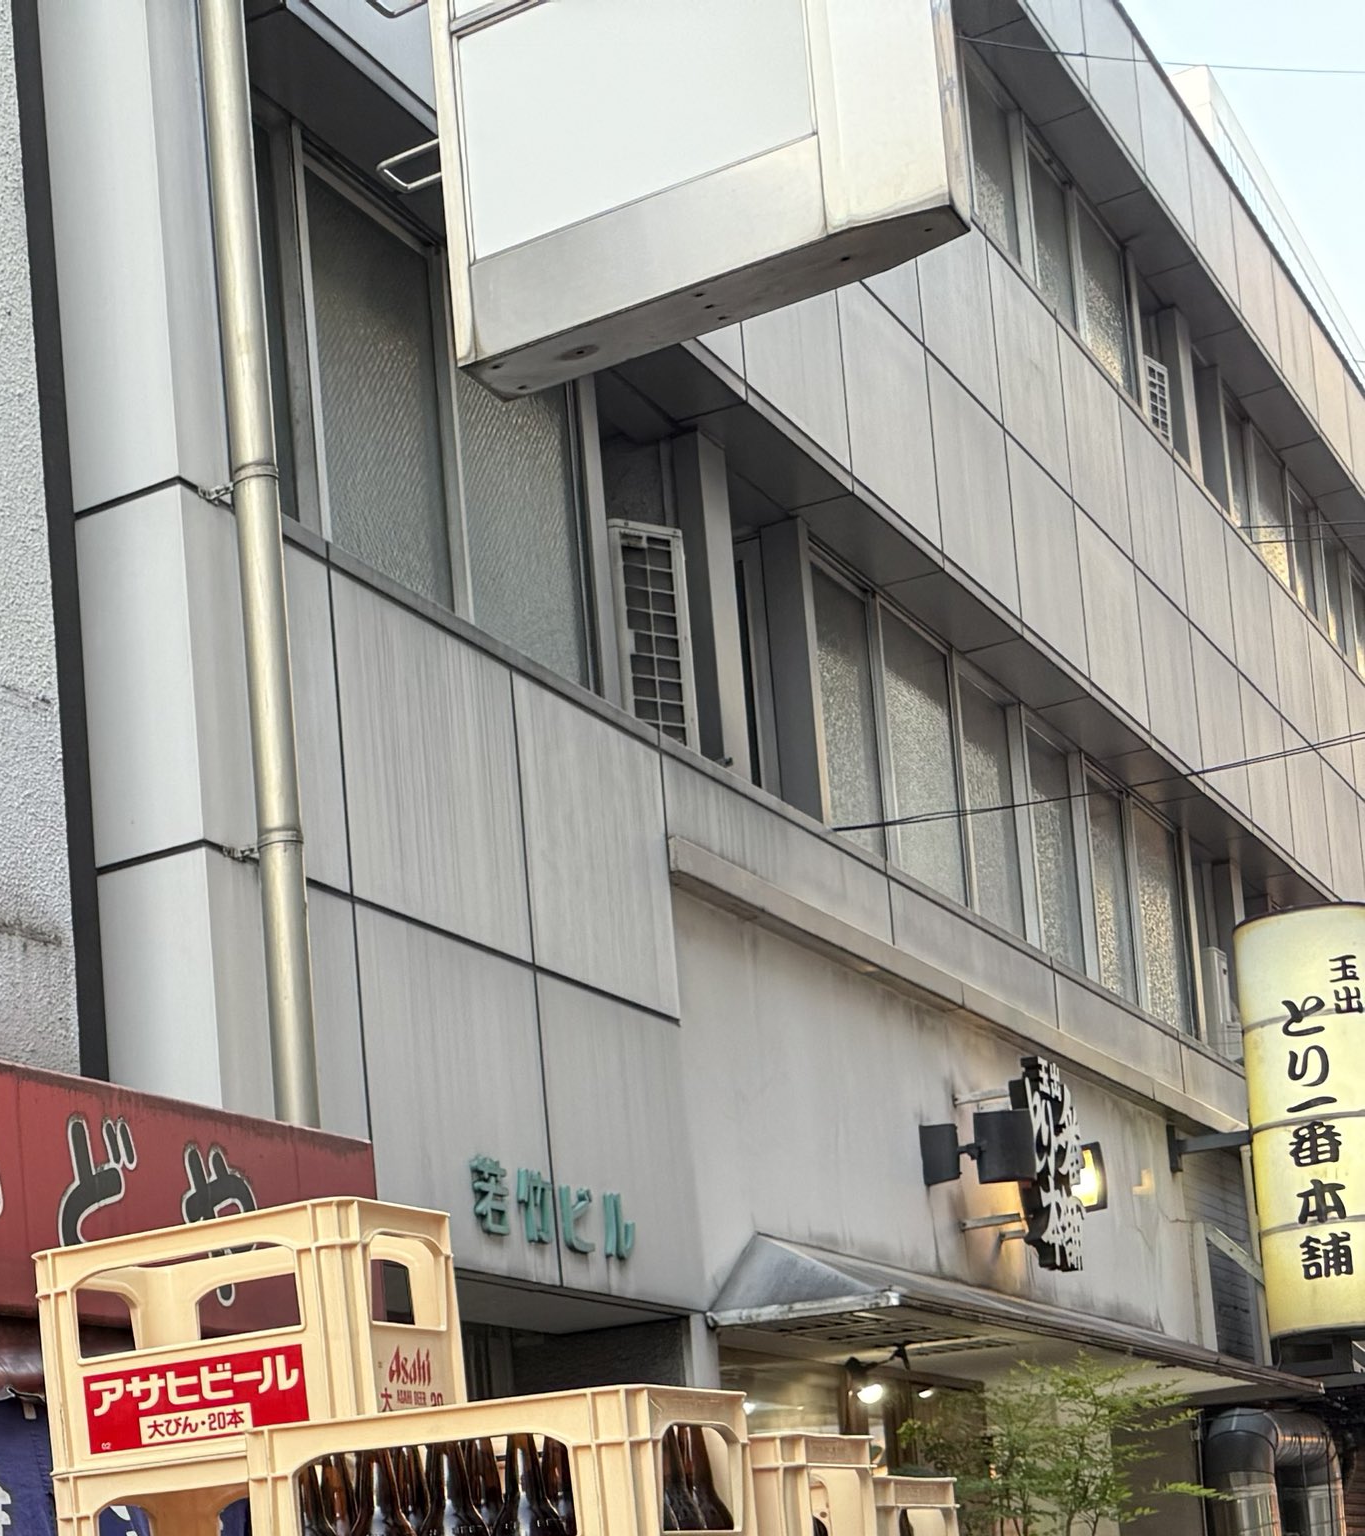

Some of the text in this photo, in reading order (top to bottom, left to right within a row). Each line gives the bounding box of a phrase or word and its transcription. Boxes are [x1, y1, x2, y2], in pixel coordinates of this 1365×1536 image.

[1329, 954, 1363, 1014] 玉出
[1281, 995, 1354, 1281] とり一番本舗
[470, 1155, 635, 1260] 若竹ビル
[89, 1354, 300, 1417] アサヒビール
[389, 1345, 431, 1387] Asahi
[147, 1408, 245, 1439] 大びん・20本
